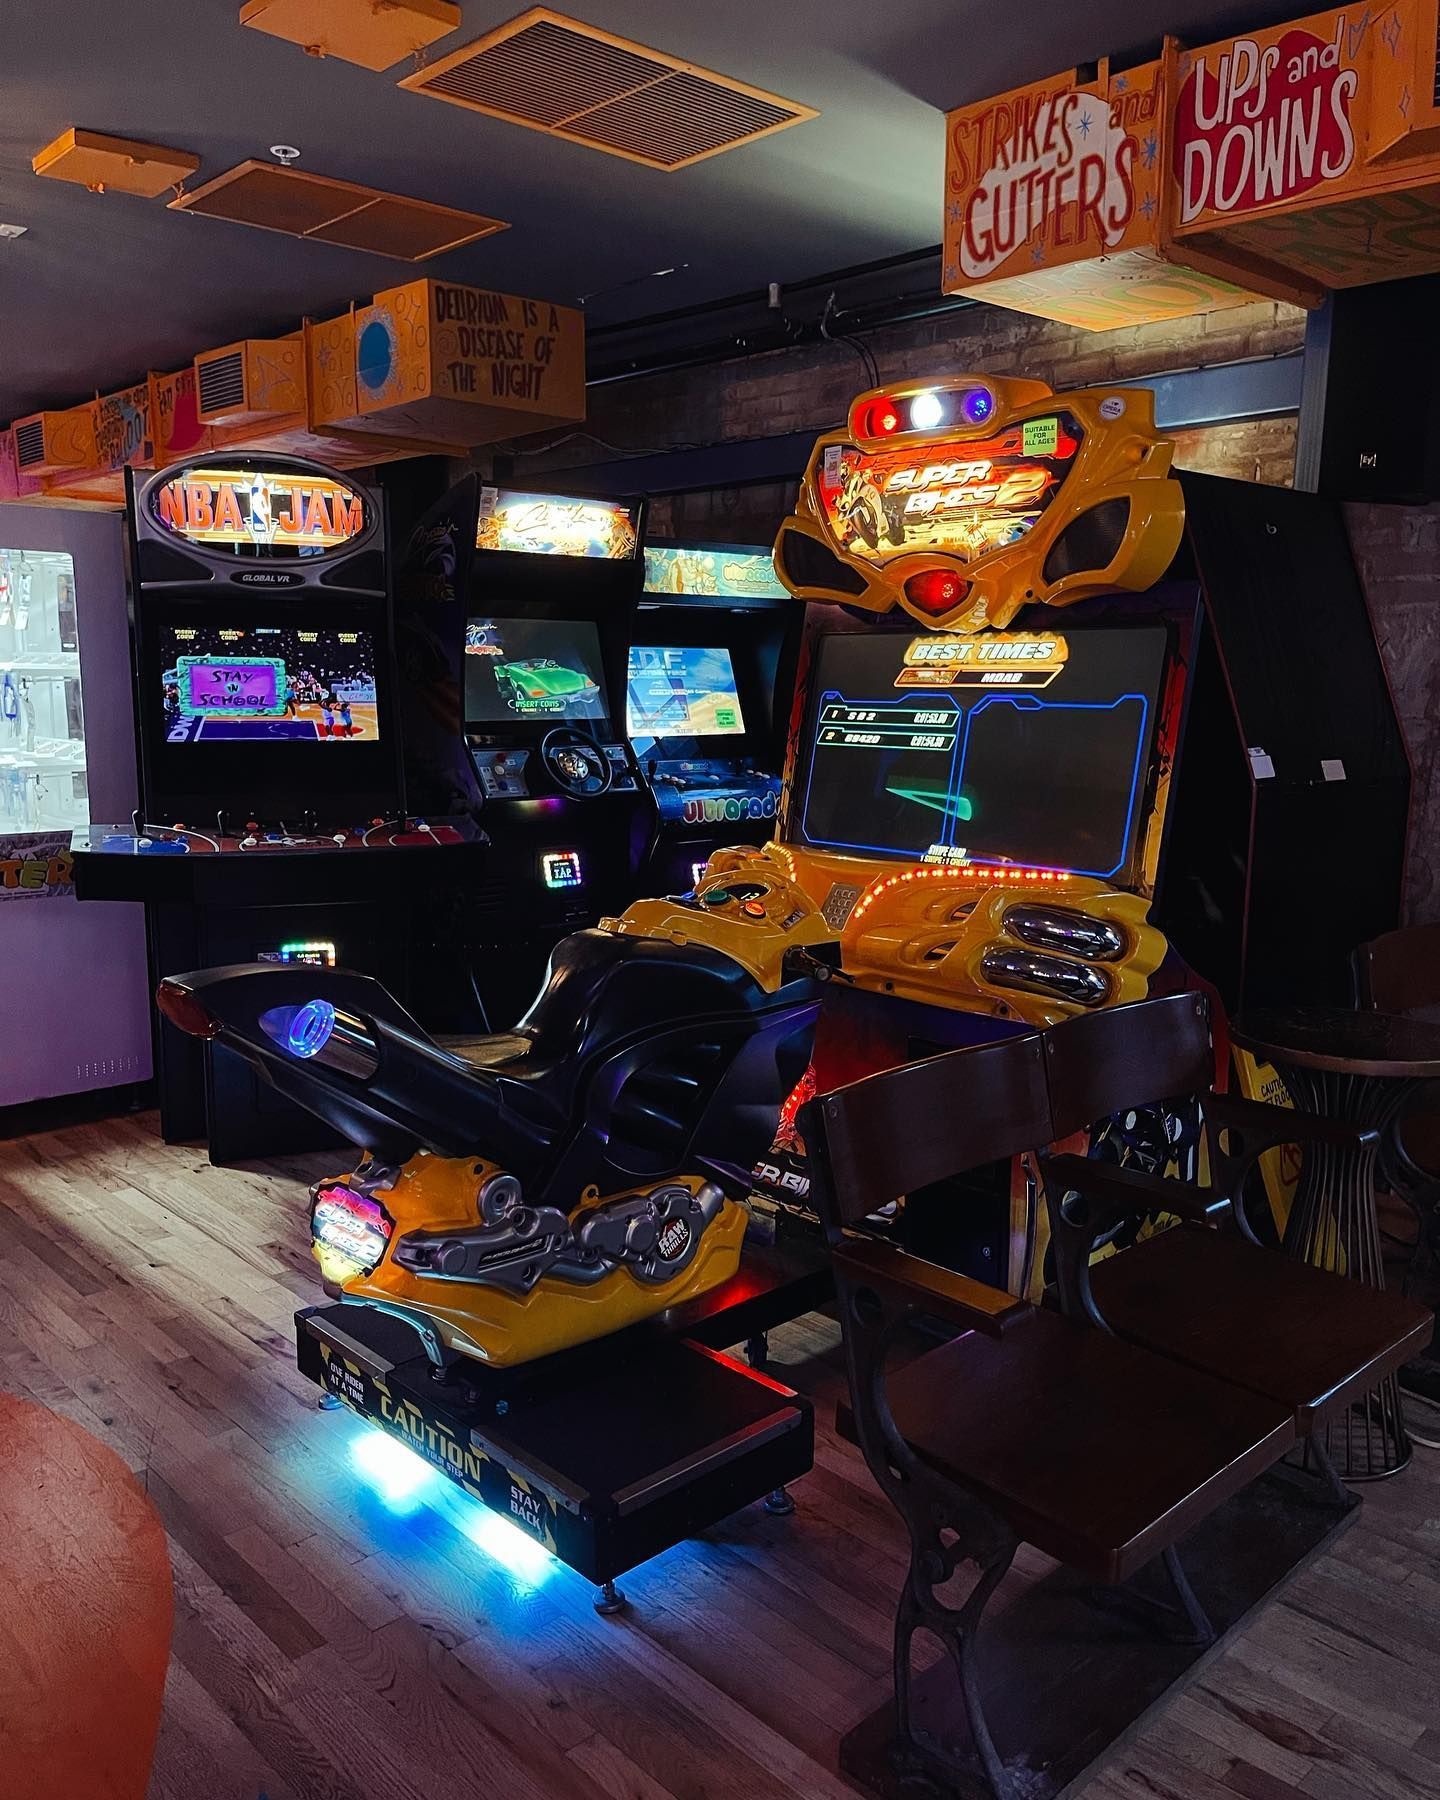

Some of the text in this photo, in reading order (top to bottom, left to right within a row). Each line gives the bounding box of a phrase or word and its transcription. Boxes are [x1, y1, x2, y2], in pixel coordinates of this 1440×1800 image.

[1194, 14, 1347, 131] UPS and
[951, 69, 1164, 194] STRIKES and
[1180, 69, 1359, 225] DOWNS
[964, 134, 1140, 263] GUTTERS
[435, 285, 561, 334] DELIRIUM IS A
[457, 326, 556, 365] DISEASE OF
[447, 360, 546, 401] THE NIGHT
[1024, 436, 1056, 447] ALL AGES
[1025, 424, 1056, 434] SUITABLE
[1033, 431, 1047, 440] FOR
[885, 459, 995, 493] SUPER
[994, 470, 1051, 508] 2
[159, 480, 363, 537] NBA JAM
[242, 574, 290, 583] GLOBAL VR
[911, 640, 1056, 662] BEST TIMES
[210, 669, 254, 684] STAY
[227, 684, 240, 693] IN
[196, 693, 270, 706] SCHOOL
[515, 700, 560, 708] INSERT COINS
[825, 731, 836, 740] 2
[658, 1218, 686, 1253] RAW
[663, 1229, 689, 1258] THRILLS
[330, 1374, 339, 1386] AT
[344, 1373, 364, 1393] RIDER
[381, 1395, 480, 1483] CAUTION
[401, 1429, 464, 1479] WATCH YOUR STEP
[510, 1486, 541, 1514] STAY
[510, 1500, 541, 1530] BACK
